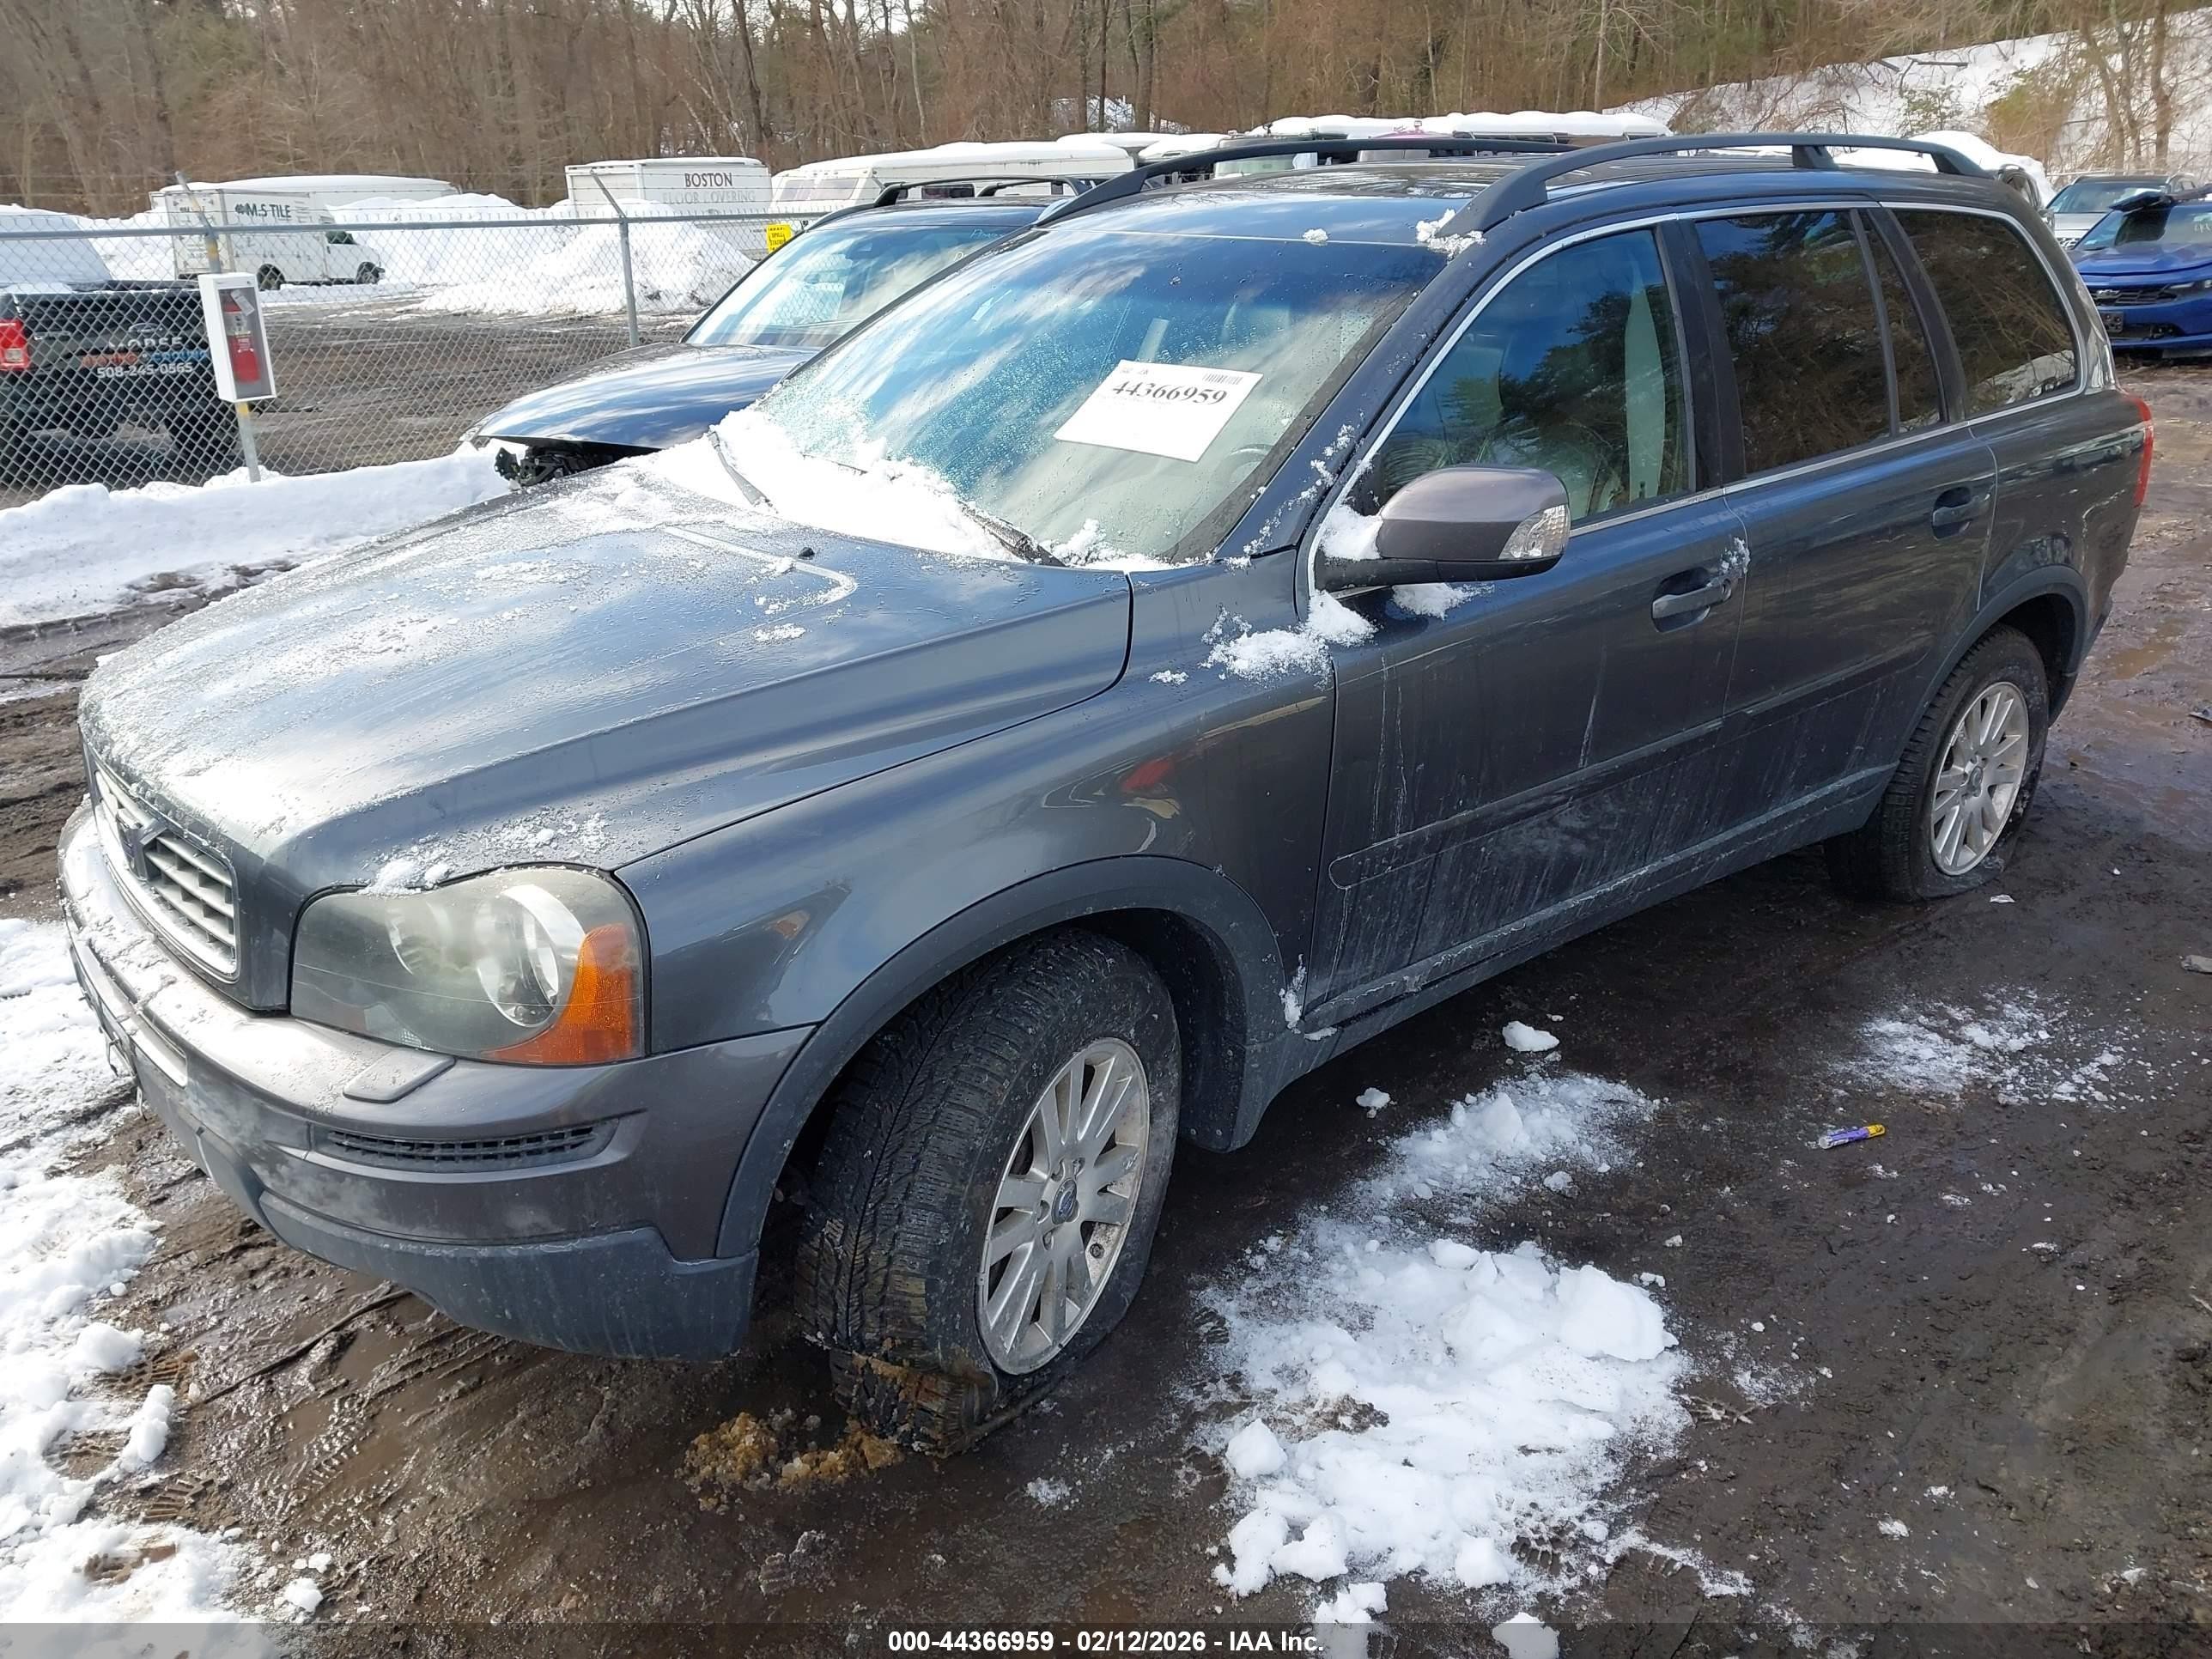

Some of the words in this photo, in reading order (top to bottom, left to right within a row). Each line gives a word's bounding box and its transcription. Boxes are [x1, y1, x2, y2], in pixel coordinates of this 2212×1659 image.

[684, 173, 733, 187] BOSTON
[662, 191, 699, 204] FLOOR
[269, 204, 292, 218] TILE
[96, 362, 193, 379] 508-245-0565
[1113, 380, 1228, 405] 44366959
